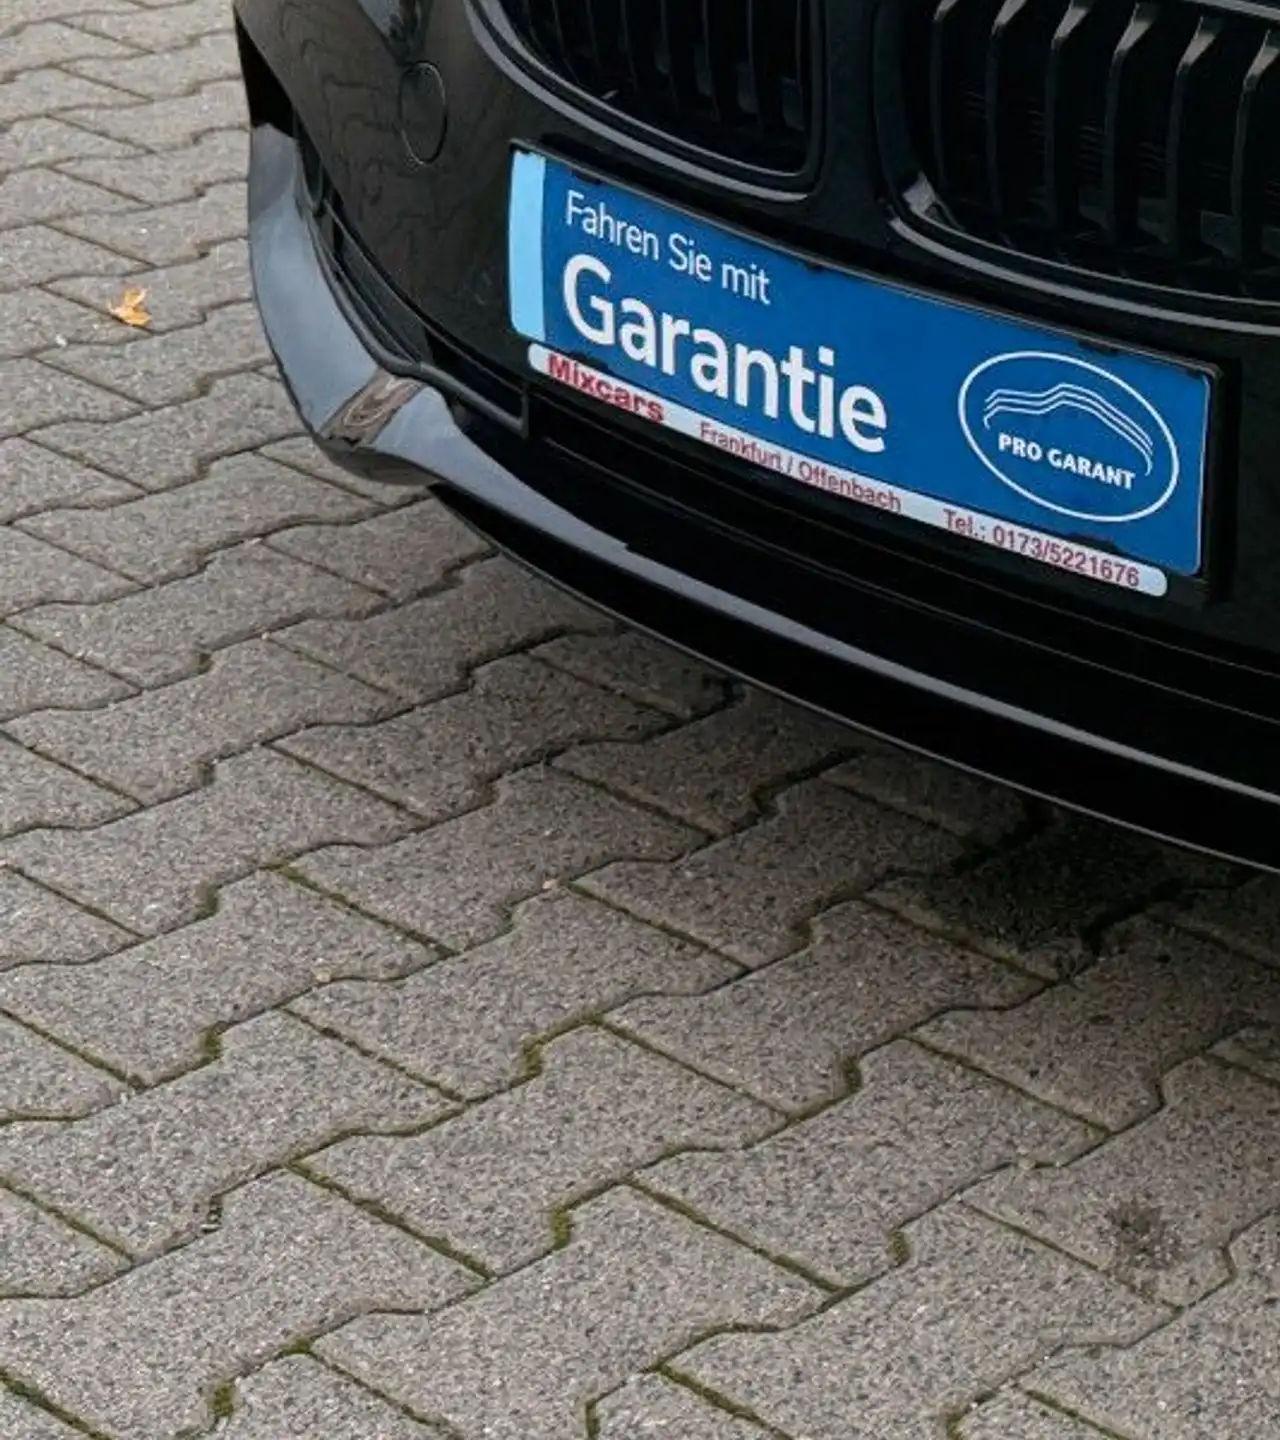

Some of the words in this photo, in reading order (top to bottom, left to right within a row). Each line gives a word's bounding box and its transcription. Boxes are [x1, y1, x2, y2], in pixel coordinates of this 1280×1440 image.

[566, 189, 660, 261] Fahren
[668, 232, 712, 283] Sie
[721, 262, 772, 306] mit
[548, 352, 665, 425] Mixcars
[563, 253, 888, 453] Garantie
[700, 420, 783, 471] Frankfurt
[798, 458, 901, 512] Offenbach
[998, 432, 1042, 462] PRO
[1046, 448, 1136, 491] GARANT
[942, 507, 987, 540] Tel.:
[992, 524, 1140, 588] 0173/5221676
